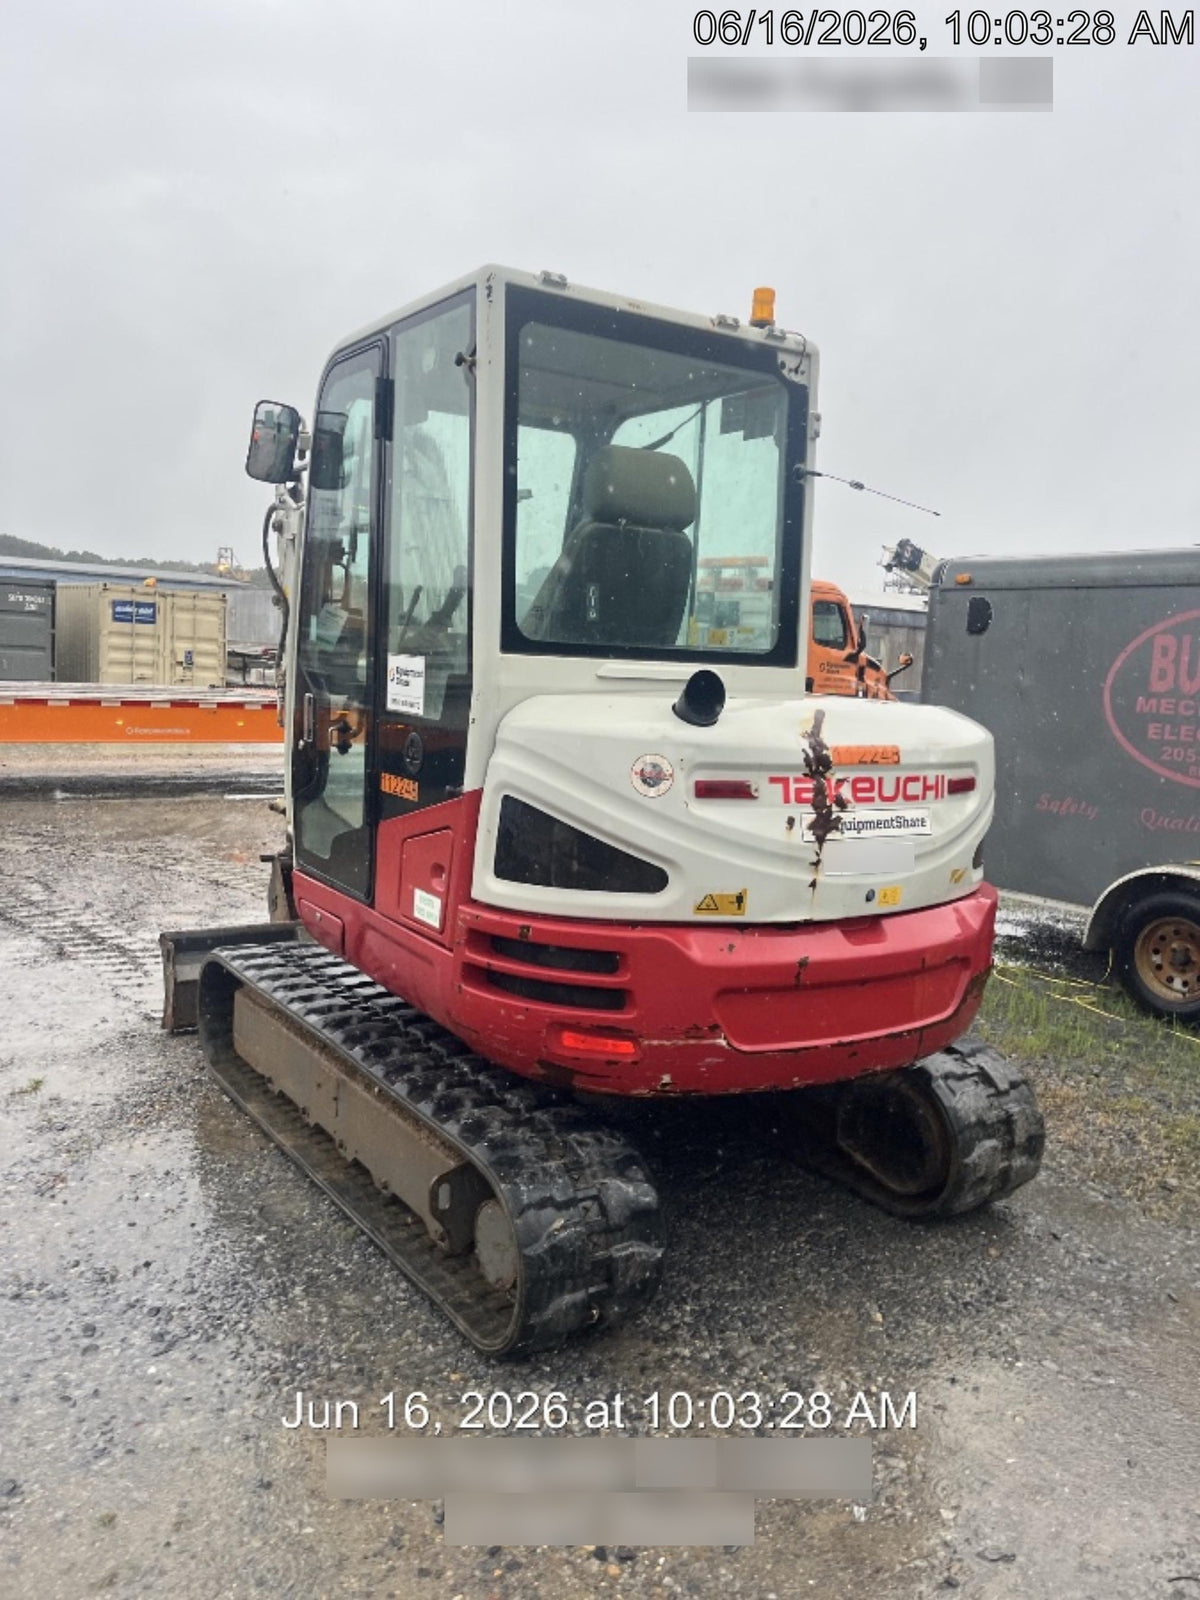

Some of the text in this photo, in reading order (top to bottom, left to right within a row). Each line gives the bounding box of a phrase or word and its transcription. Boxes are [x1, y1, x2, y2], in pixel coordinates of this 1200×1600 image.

[1135, 696, 1200, 717] MEC
[1036, 793, 1099, 821] Safety
[832, 814, 928, 836] quipmentShare
